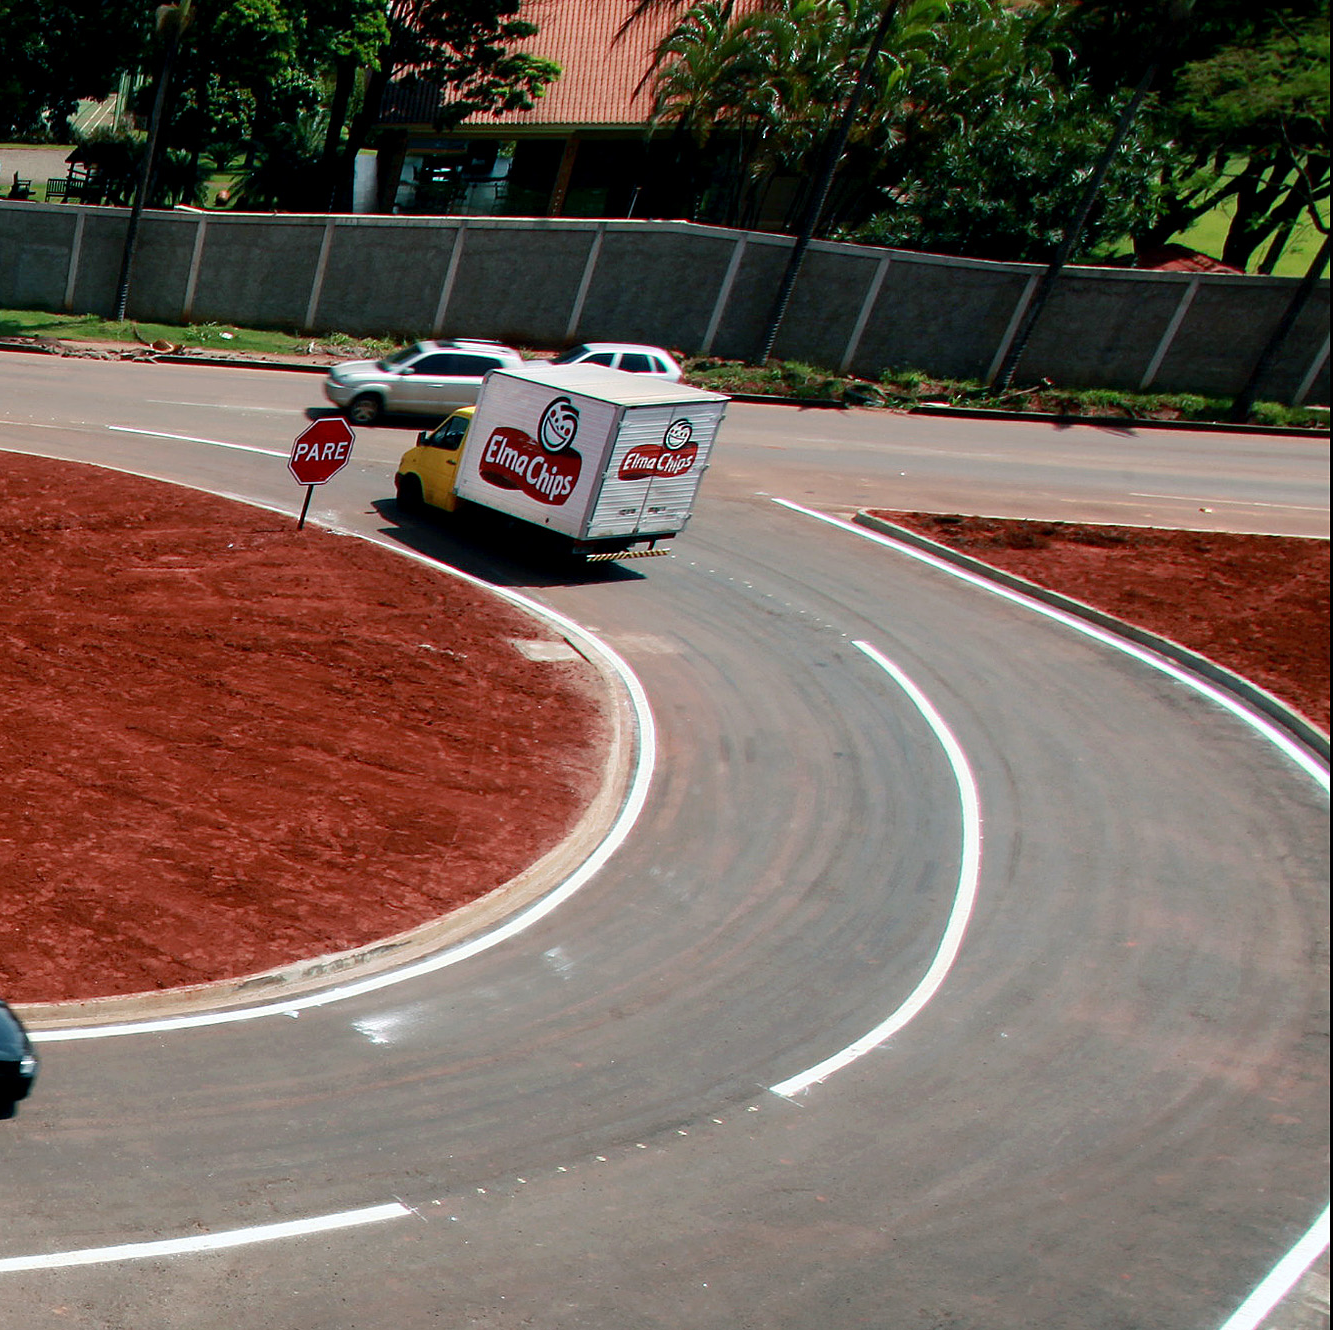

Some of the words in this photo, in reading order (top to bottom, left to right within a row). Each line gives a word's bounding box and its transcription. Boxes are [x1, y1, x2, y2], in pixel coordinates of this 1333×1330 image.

[294, 442, 348, 462] PARE
[485, 435, 529, 476] Elma
[526, 456, 573, 501] Chips
[623, 453, 656, 471] Elma
[656, 453, 693, 474] Chips
